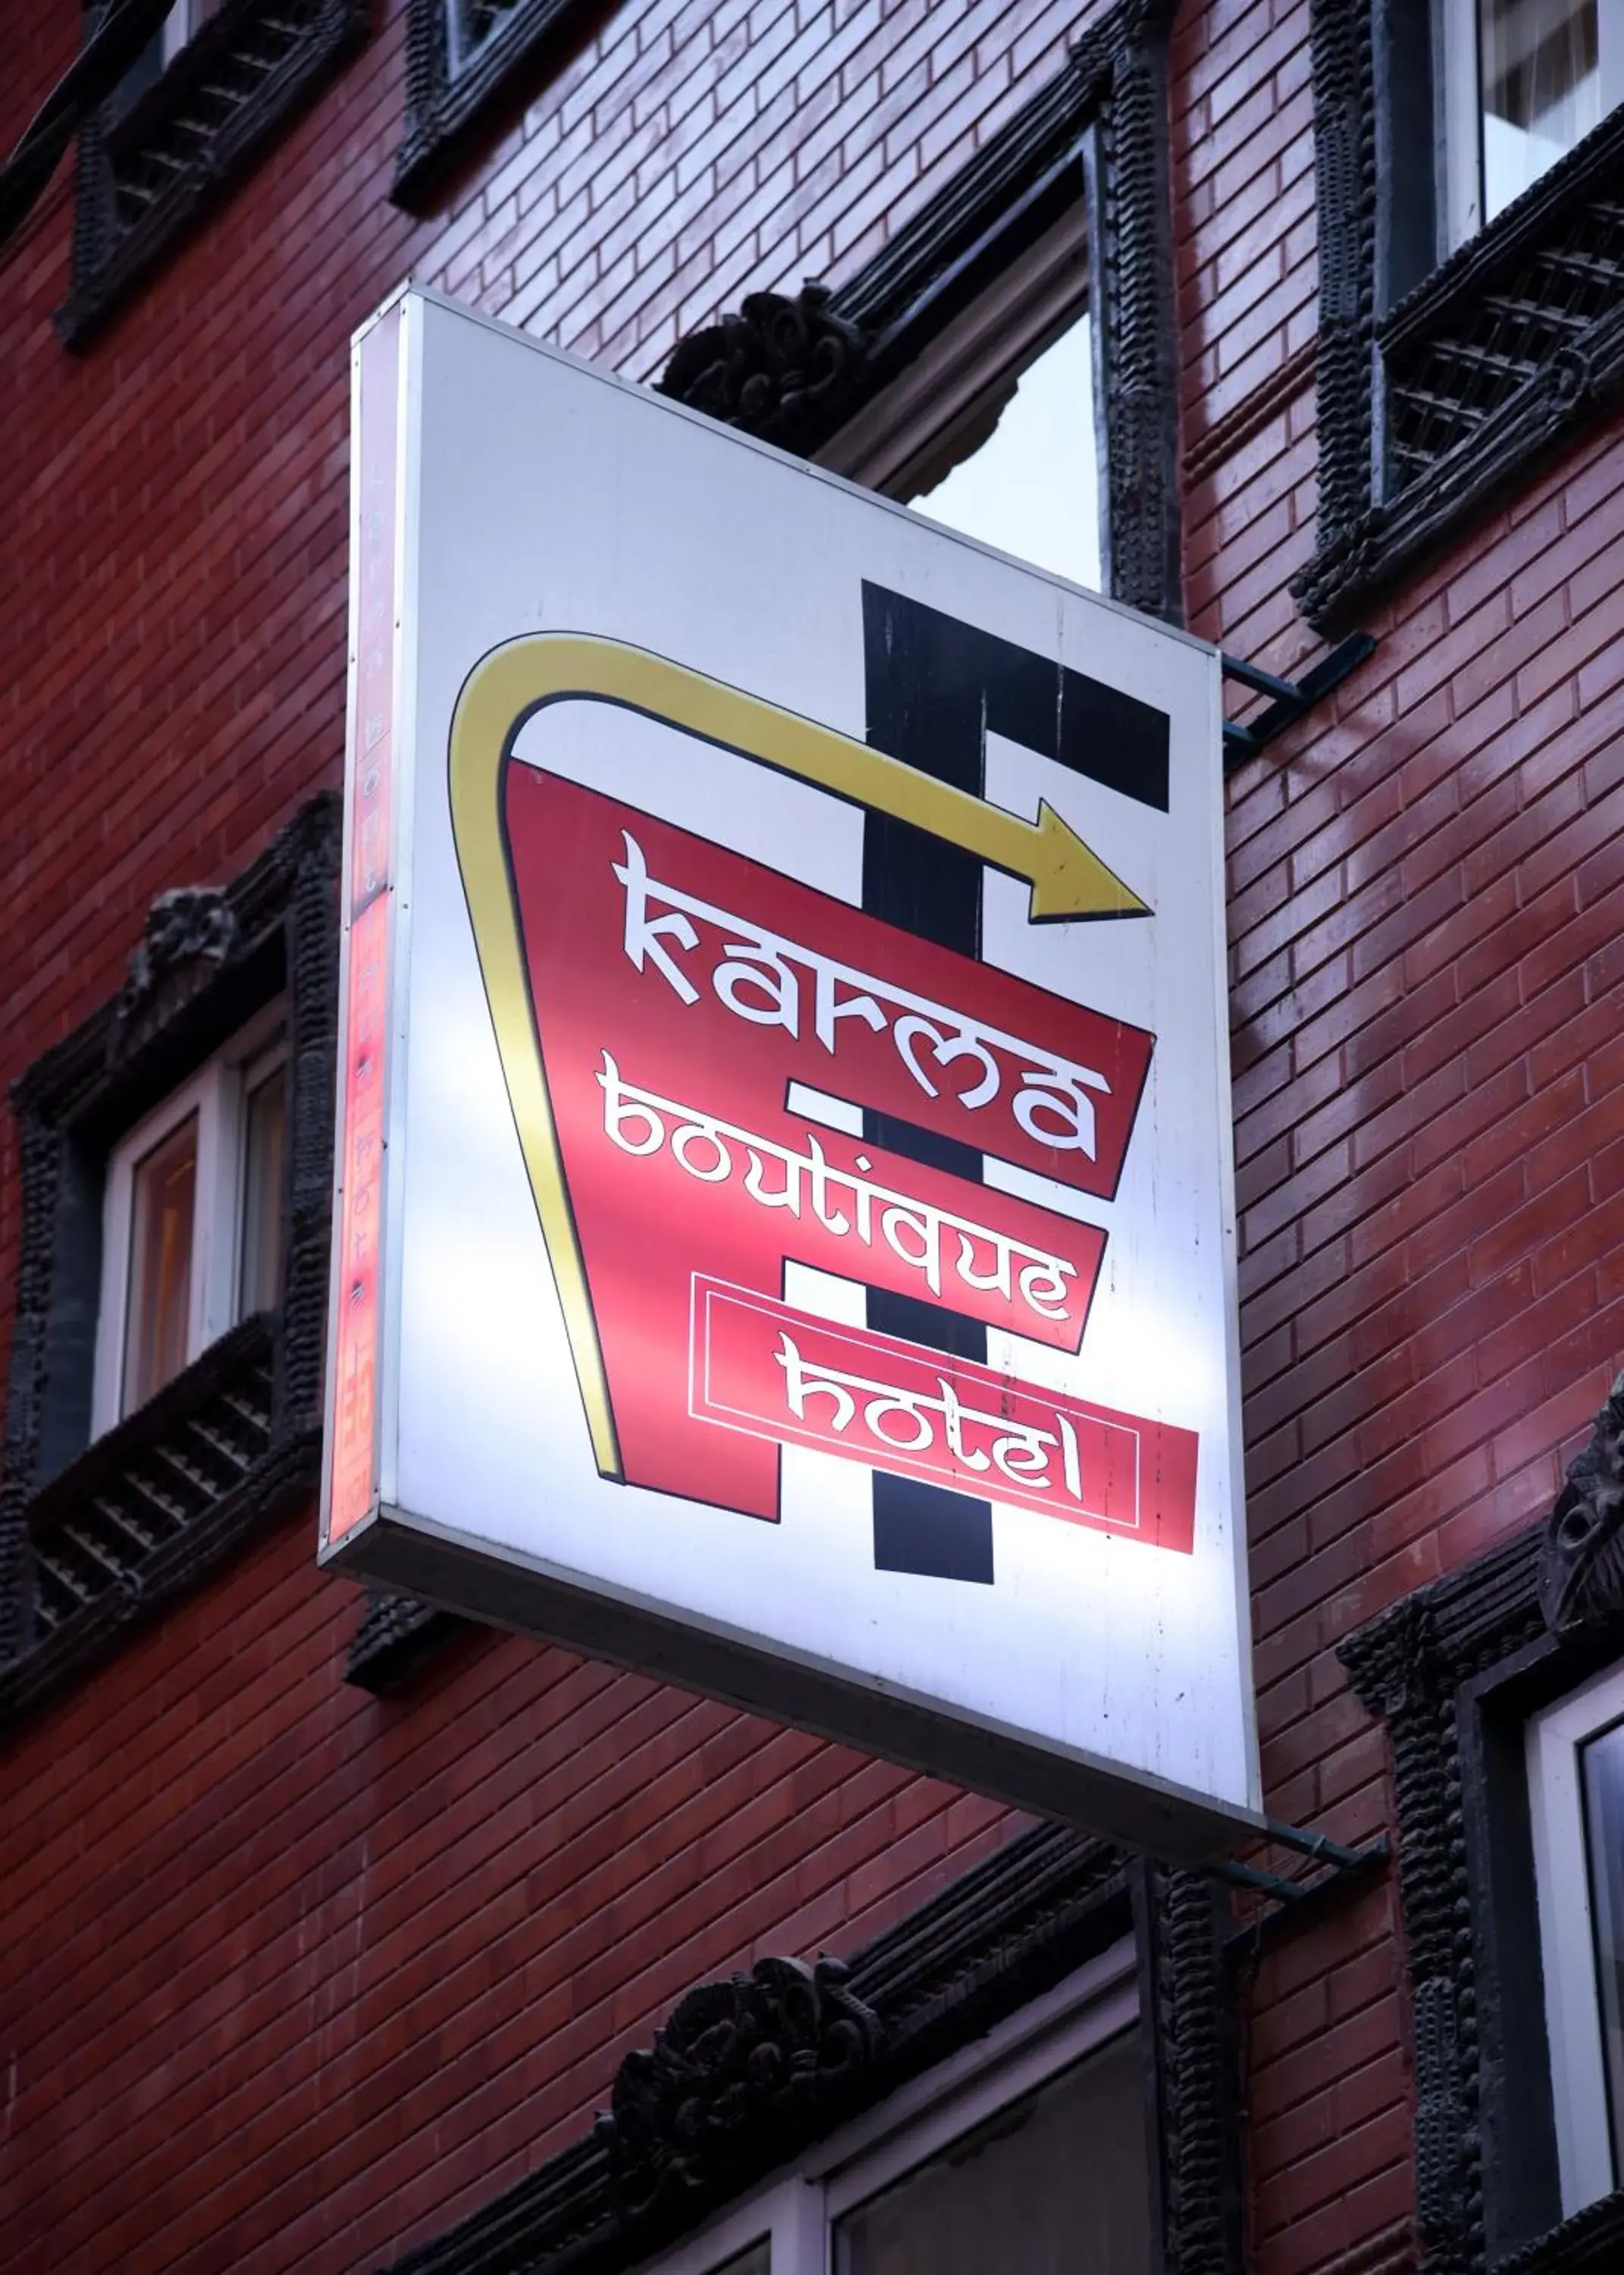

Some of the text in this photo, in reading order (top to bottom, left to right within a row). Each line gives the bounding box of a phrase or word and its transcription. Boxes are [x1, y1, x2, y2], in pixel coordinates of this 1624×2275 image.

[610, 830, 1113, 1162] karma
[595, 1050, 1078, 1320] boutique
[772, 1332, 1083, 1501] hotel
